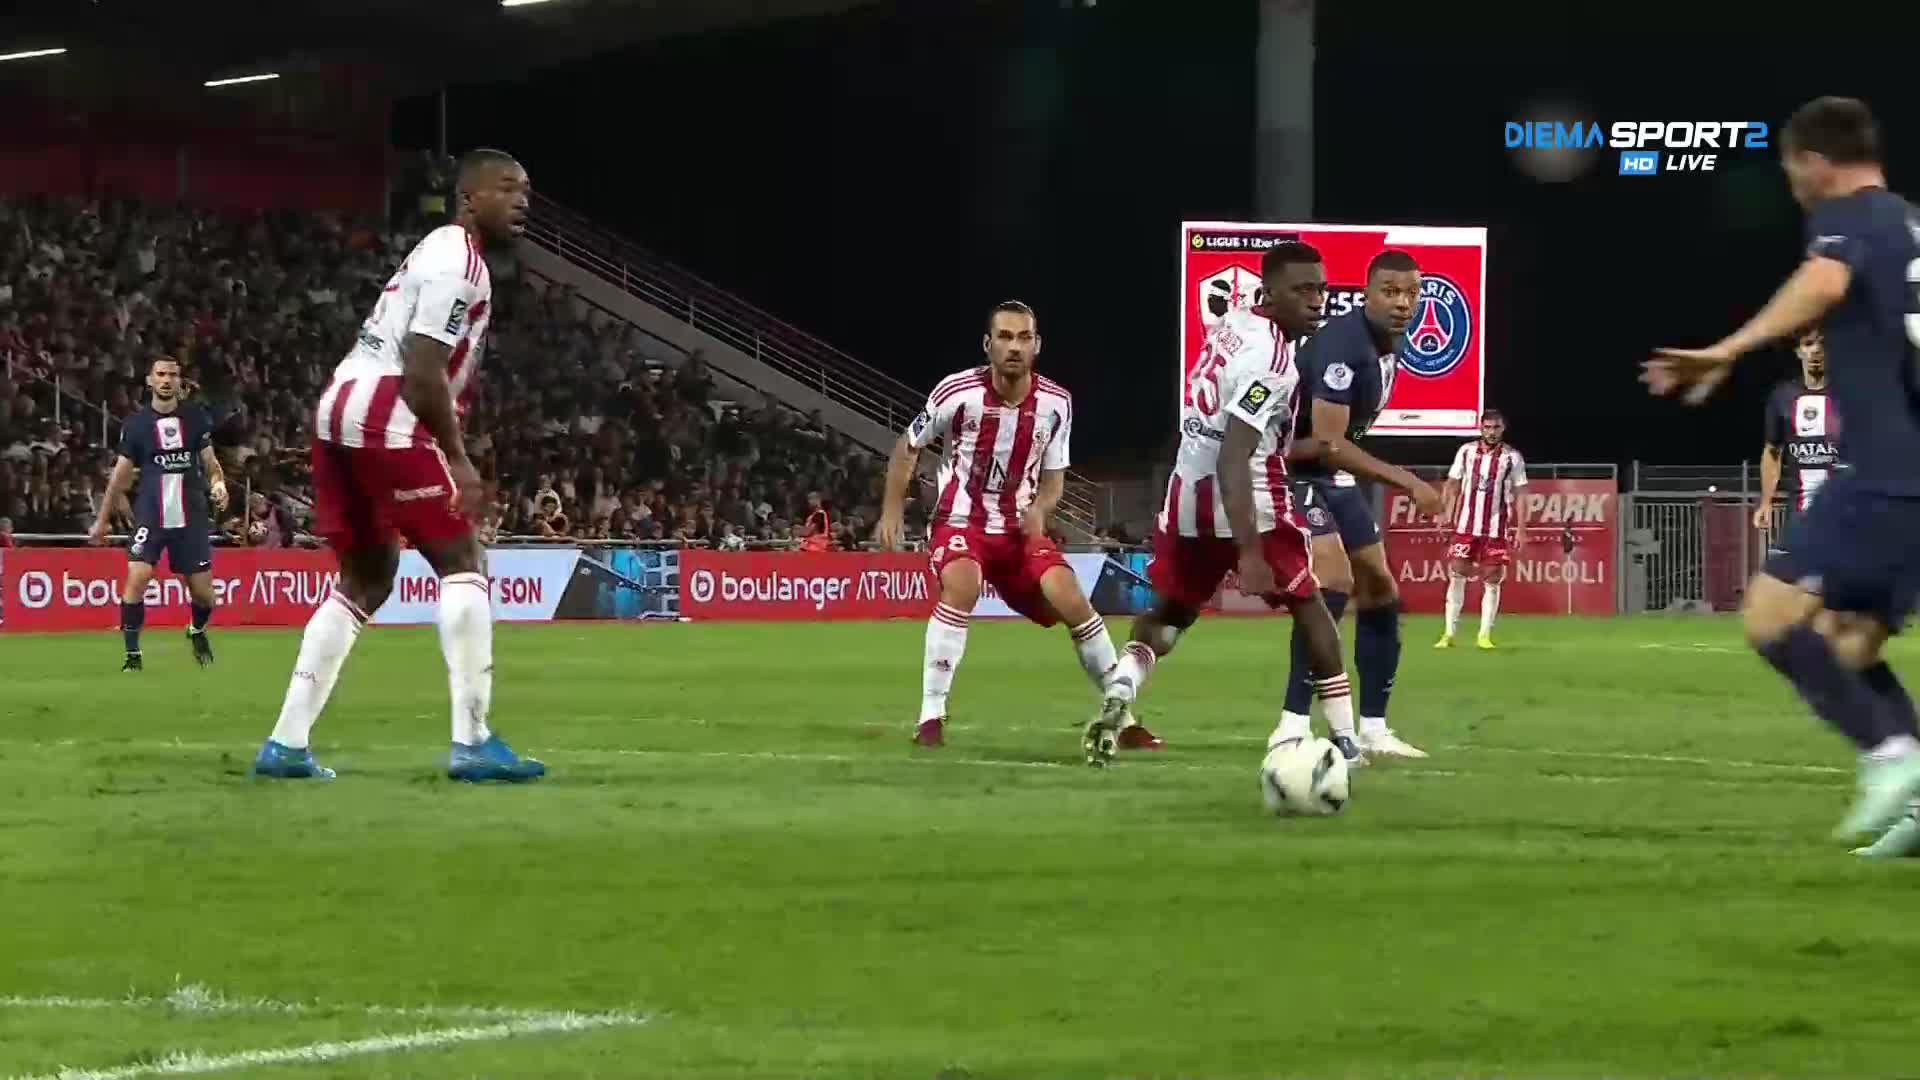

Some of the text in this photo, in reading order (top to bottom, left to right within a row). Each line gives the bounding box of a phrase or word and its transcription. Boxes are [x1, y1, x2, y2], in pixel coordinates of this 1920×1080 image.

[1206, 237, 1240, 247] LIGUE
[1525, 493, 1610, 523] PARK
[134, 526, 149, 543] 8
[1515, 559, 1604, 583] NICOLI
[500, 577, 542, 604] SON
[722, 571, 928, 609] boulanger ATRIUM
